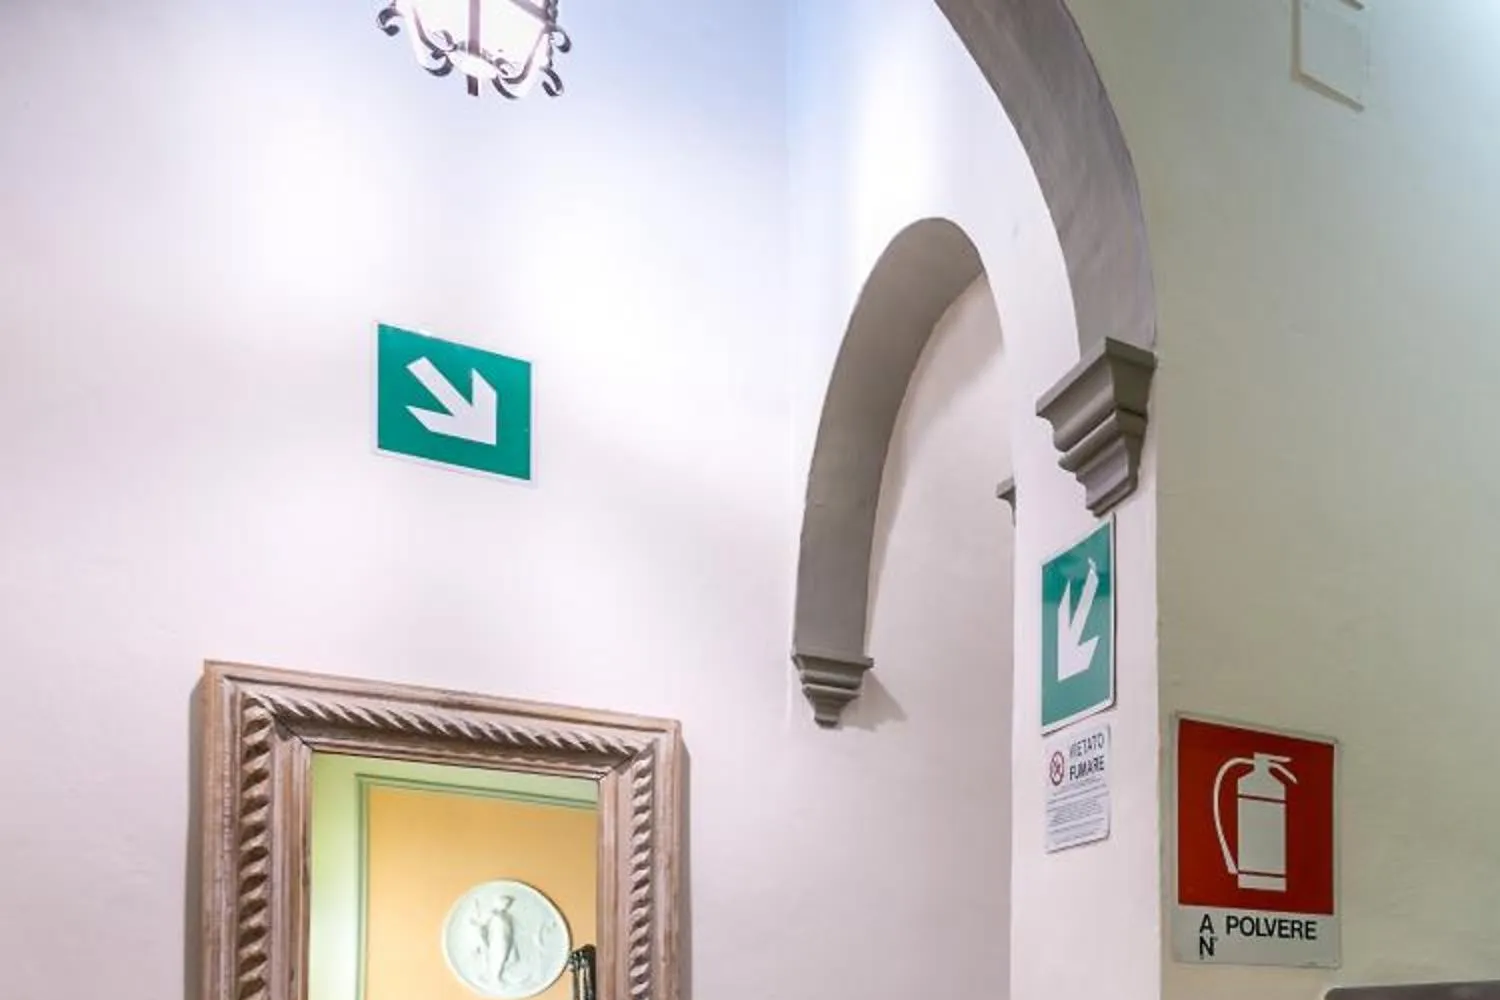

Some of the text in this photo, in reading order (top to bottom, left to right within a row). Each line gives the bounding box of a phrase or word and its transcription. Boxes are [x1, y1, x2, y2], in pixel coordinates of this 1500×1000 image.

[1069, 755, 1105, 780] FUMARE
[1199, 913, 1318, 940] A POLVERE
